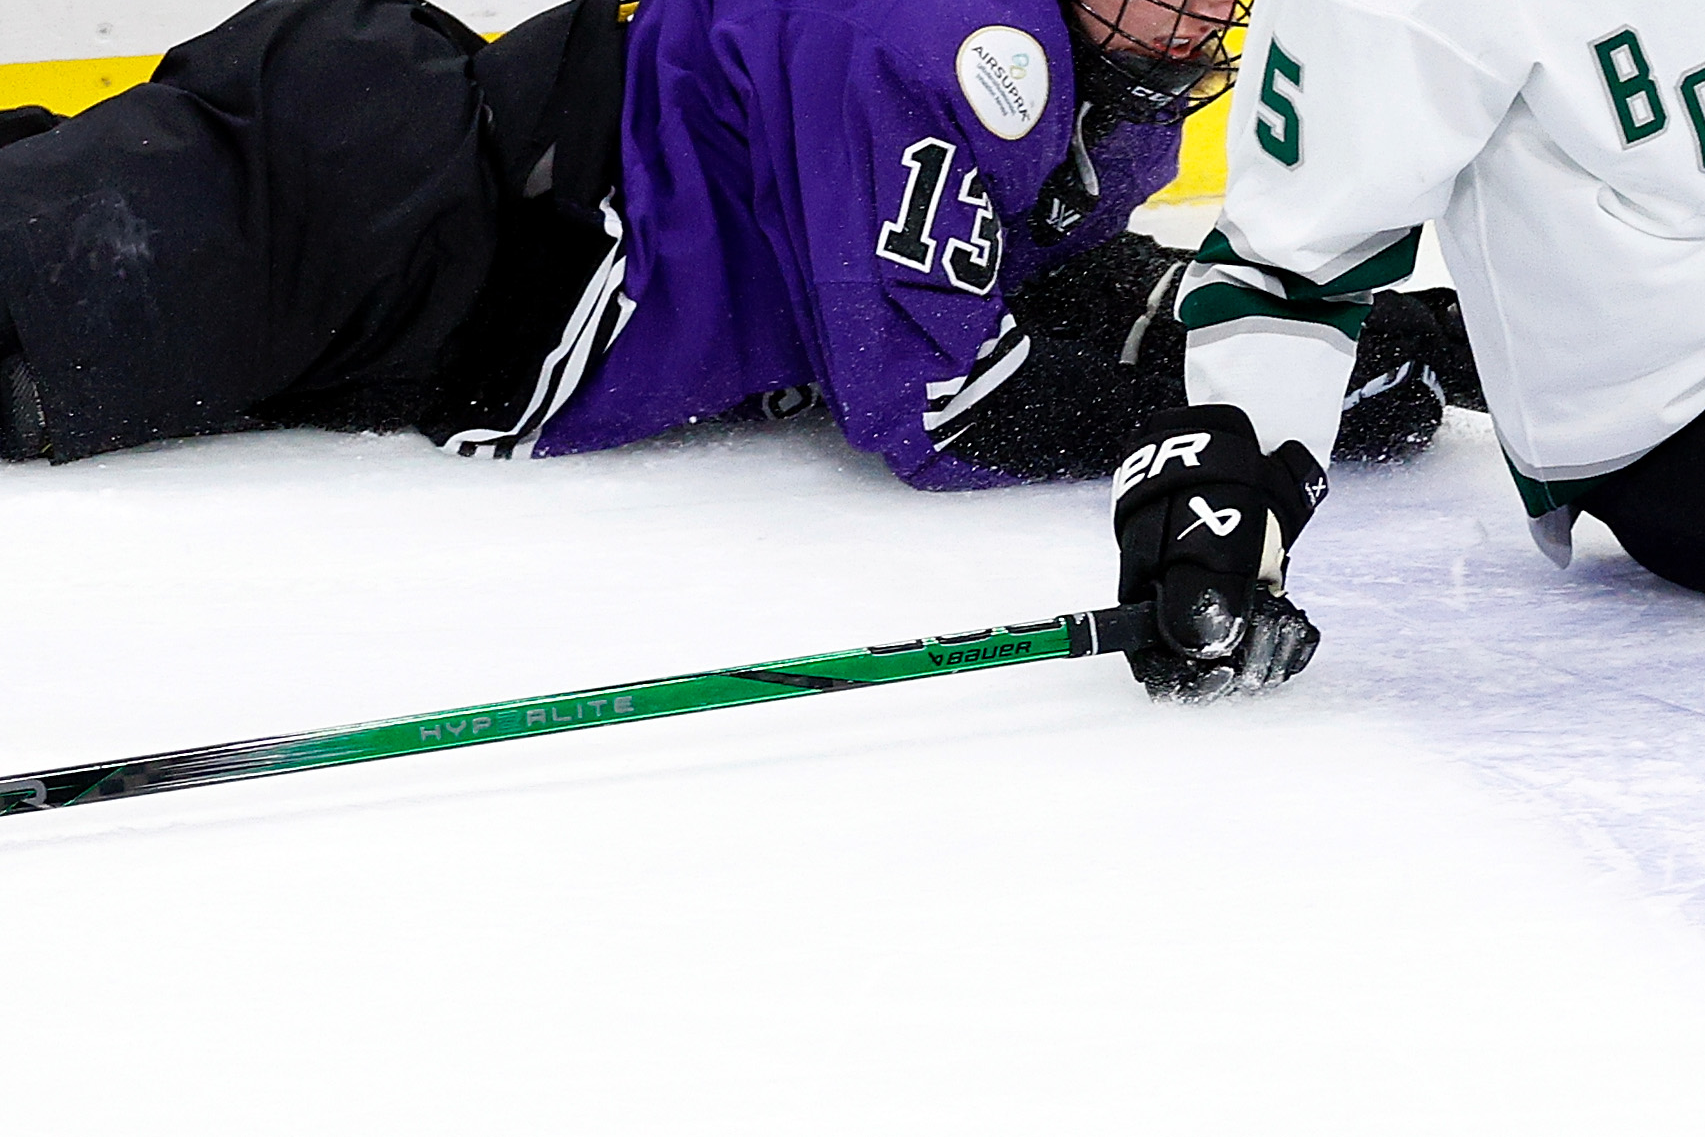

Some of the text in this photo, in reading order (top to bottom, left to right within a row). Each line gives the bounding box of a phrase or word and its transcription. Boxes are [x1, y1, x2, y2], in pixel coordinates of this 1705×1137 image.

[971, 46, 1030, 122] AIRSUPRA
[1254, 33, 1305, 171] 5
[876, 137, 1003, 295] 13
[946, 641, 1032, 666] BAUER
